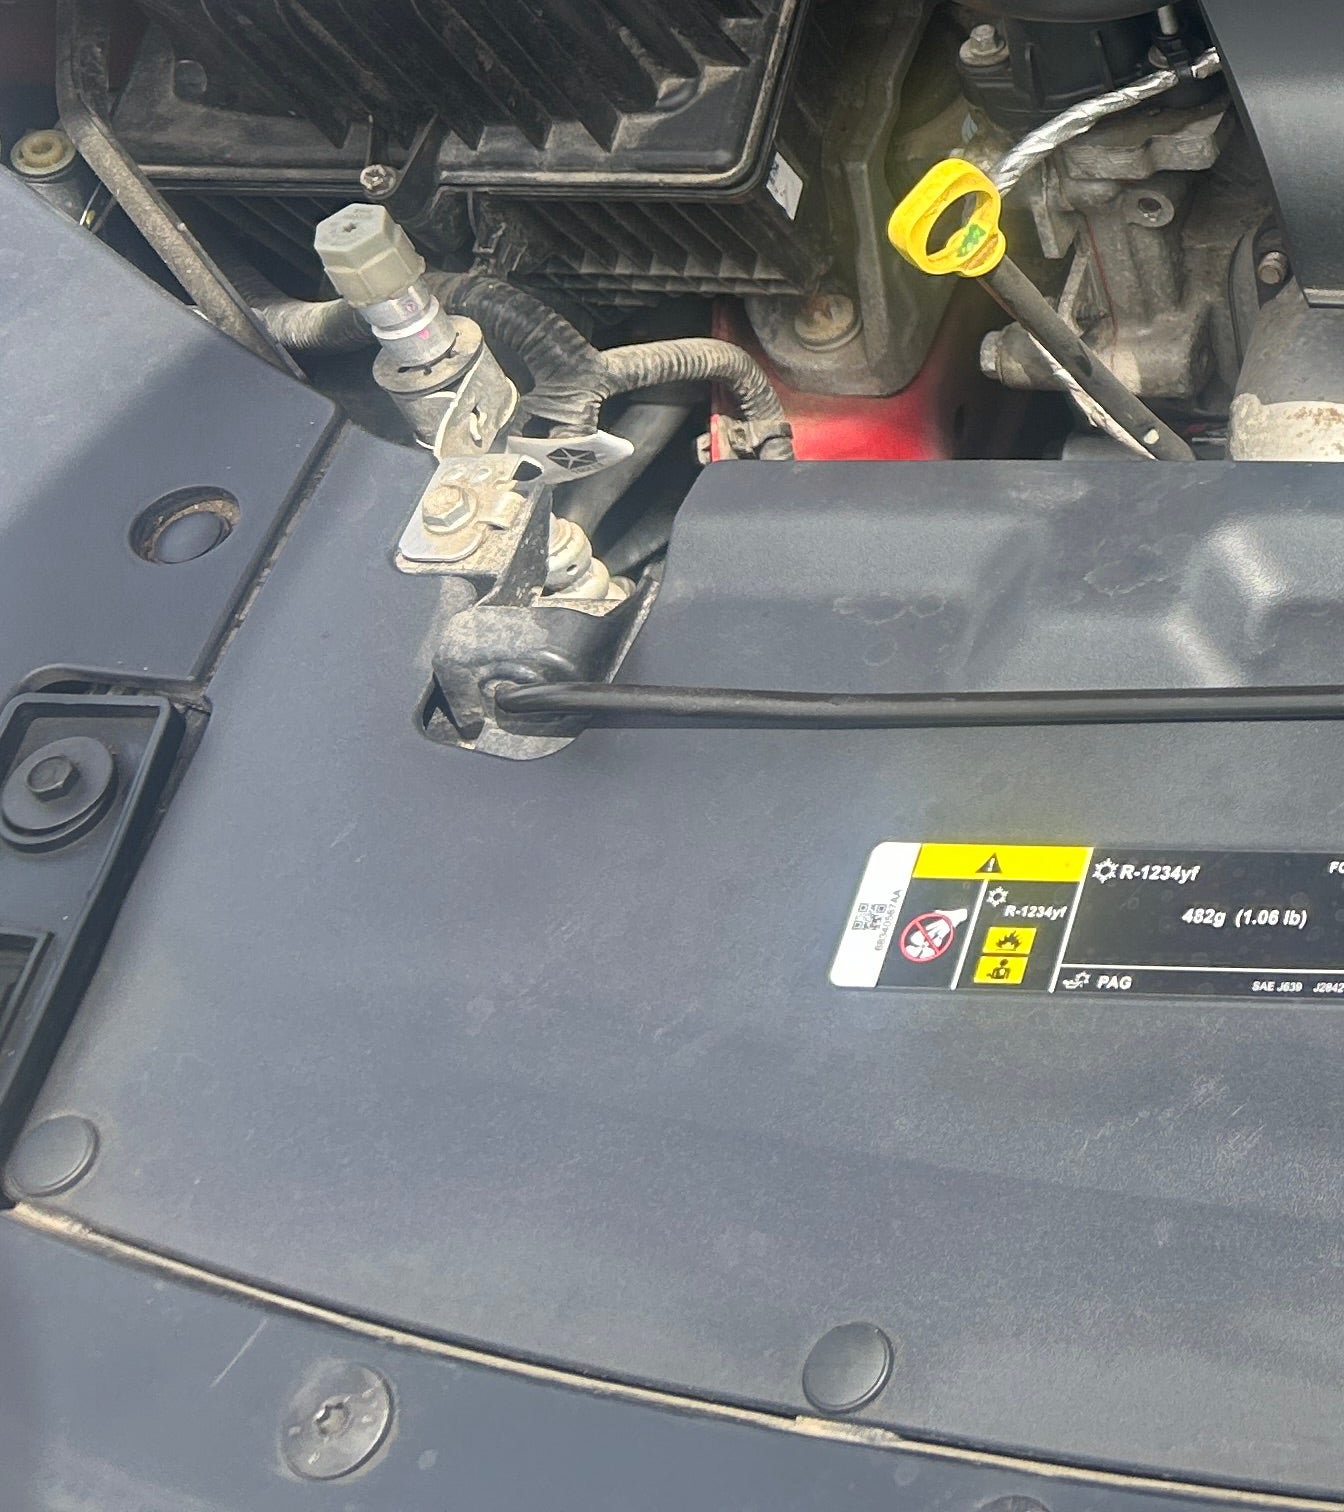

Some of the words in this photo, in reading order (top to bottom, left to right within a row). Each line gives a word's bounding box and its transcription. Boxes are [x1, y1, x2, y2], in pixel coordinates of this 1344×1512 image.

[1119, 864, 1201, 885] R-1234yf
[1004, 904, 1068, 921] R-1234yf
[1181, 908, 1227, 928] 482g
[1234, 909, 1280, 928] (1.06
[1282, 909, 1308, 930] lb)
[1096, 975, 1133, 990] PAG
[1252, 981, 1275, 992] SAE
